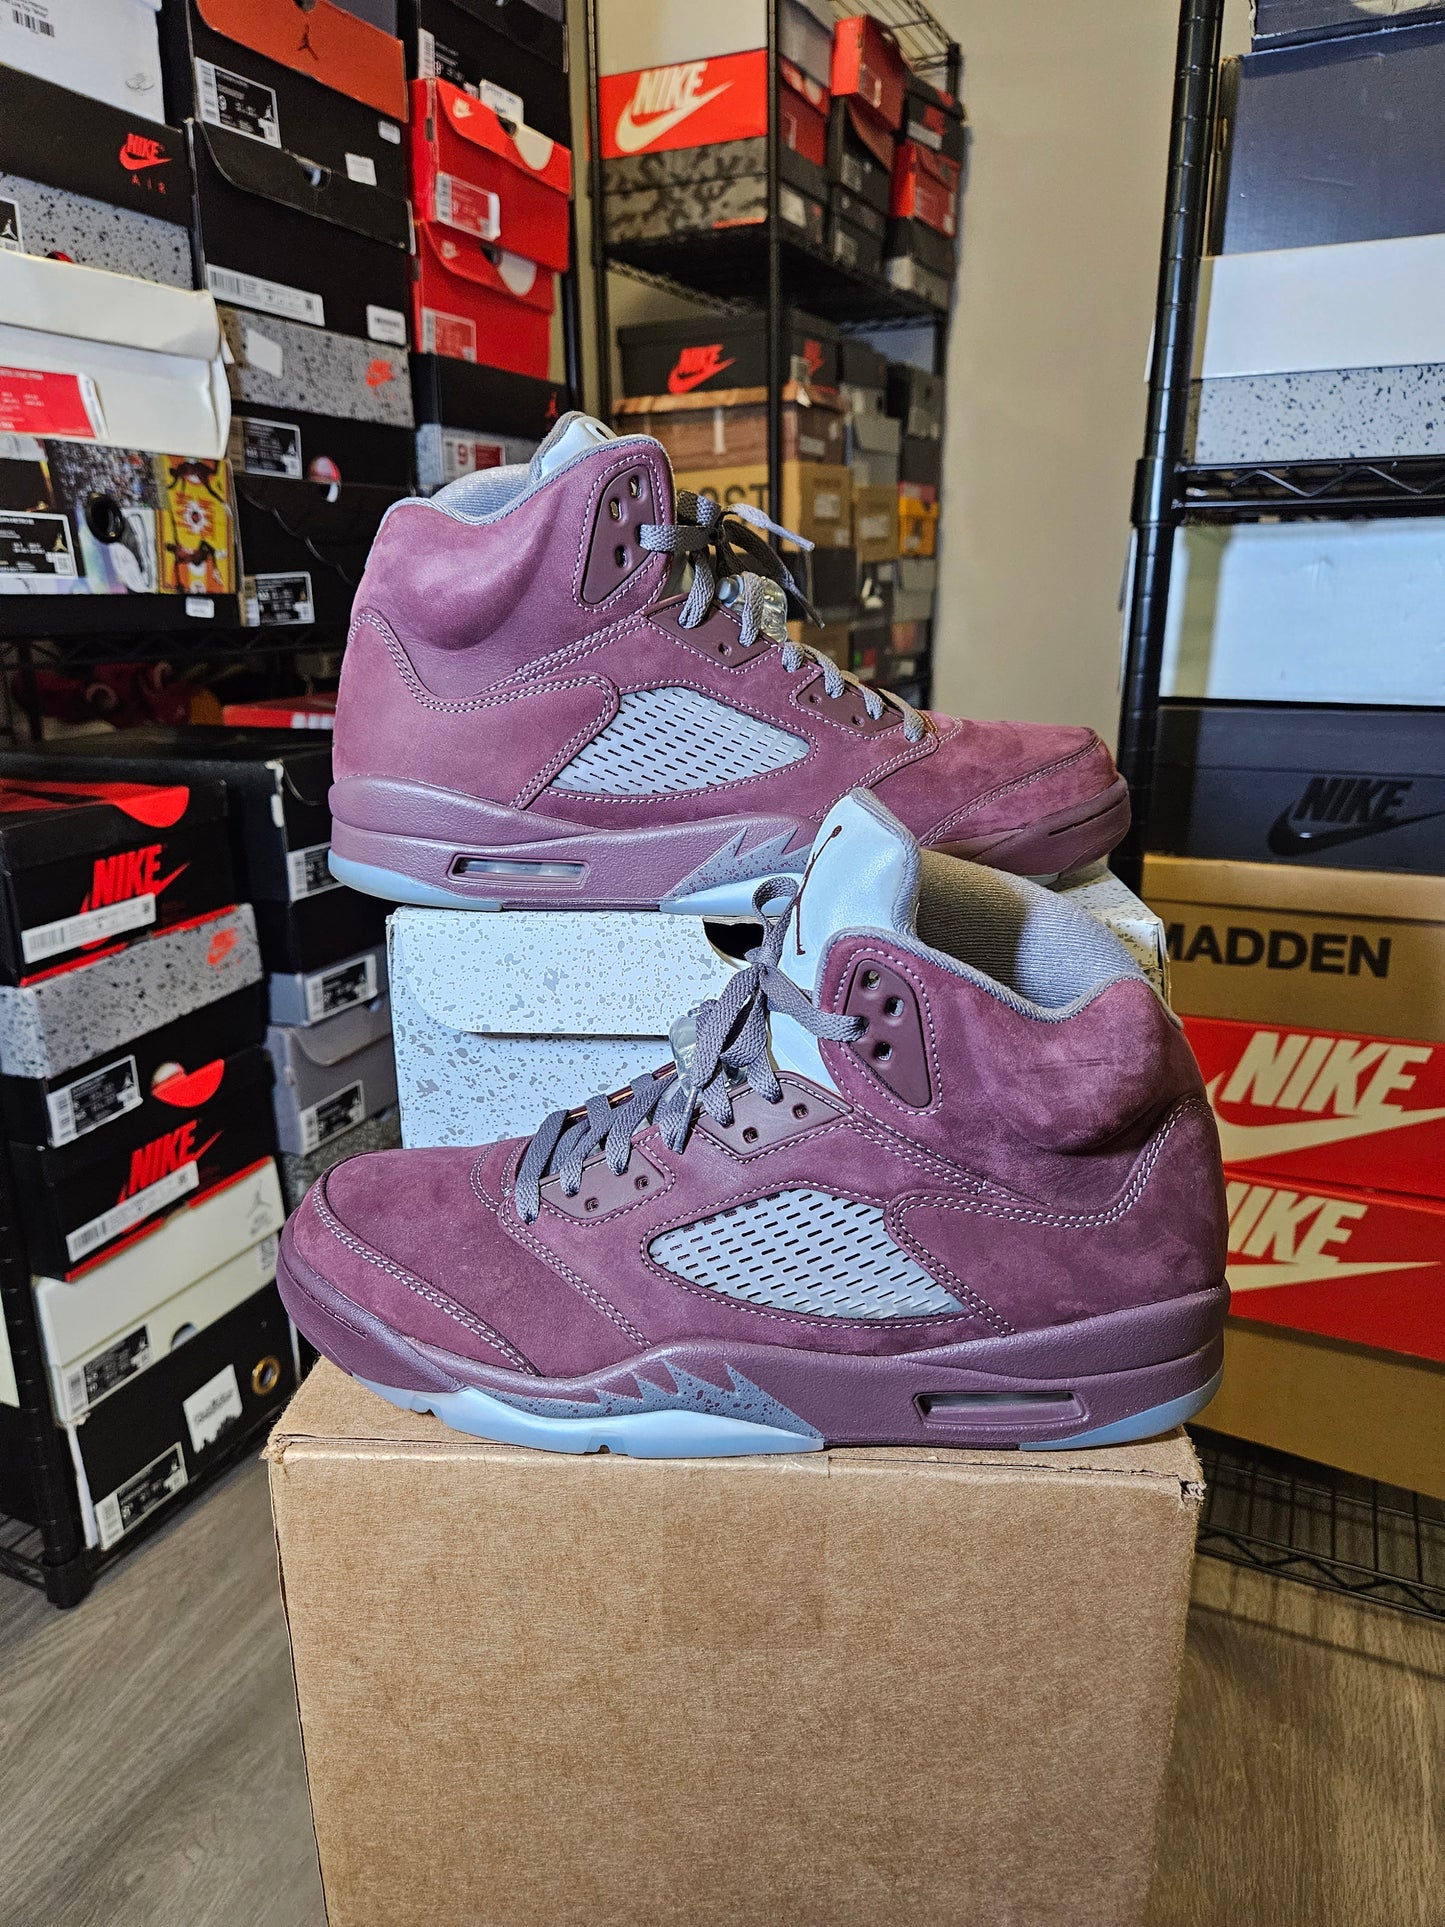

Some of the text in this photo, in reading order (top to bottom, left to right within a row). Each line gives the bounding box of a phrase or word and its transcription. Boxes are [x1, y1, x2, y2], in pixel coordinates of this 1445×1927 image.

[631, 60, 708, 116] NIKE
[127, 133, 160, 159] NIKE
[131, 173, 166, 194] AIR
[1293, 776, 1413, 823] NIKE
[91, 844, 162, 909] NIKE
[1220, 1030, 1433, 1116] NIKE
[128, 1119, 197, 1196] NIKE
